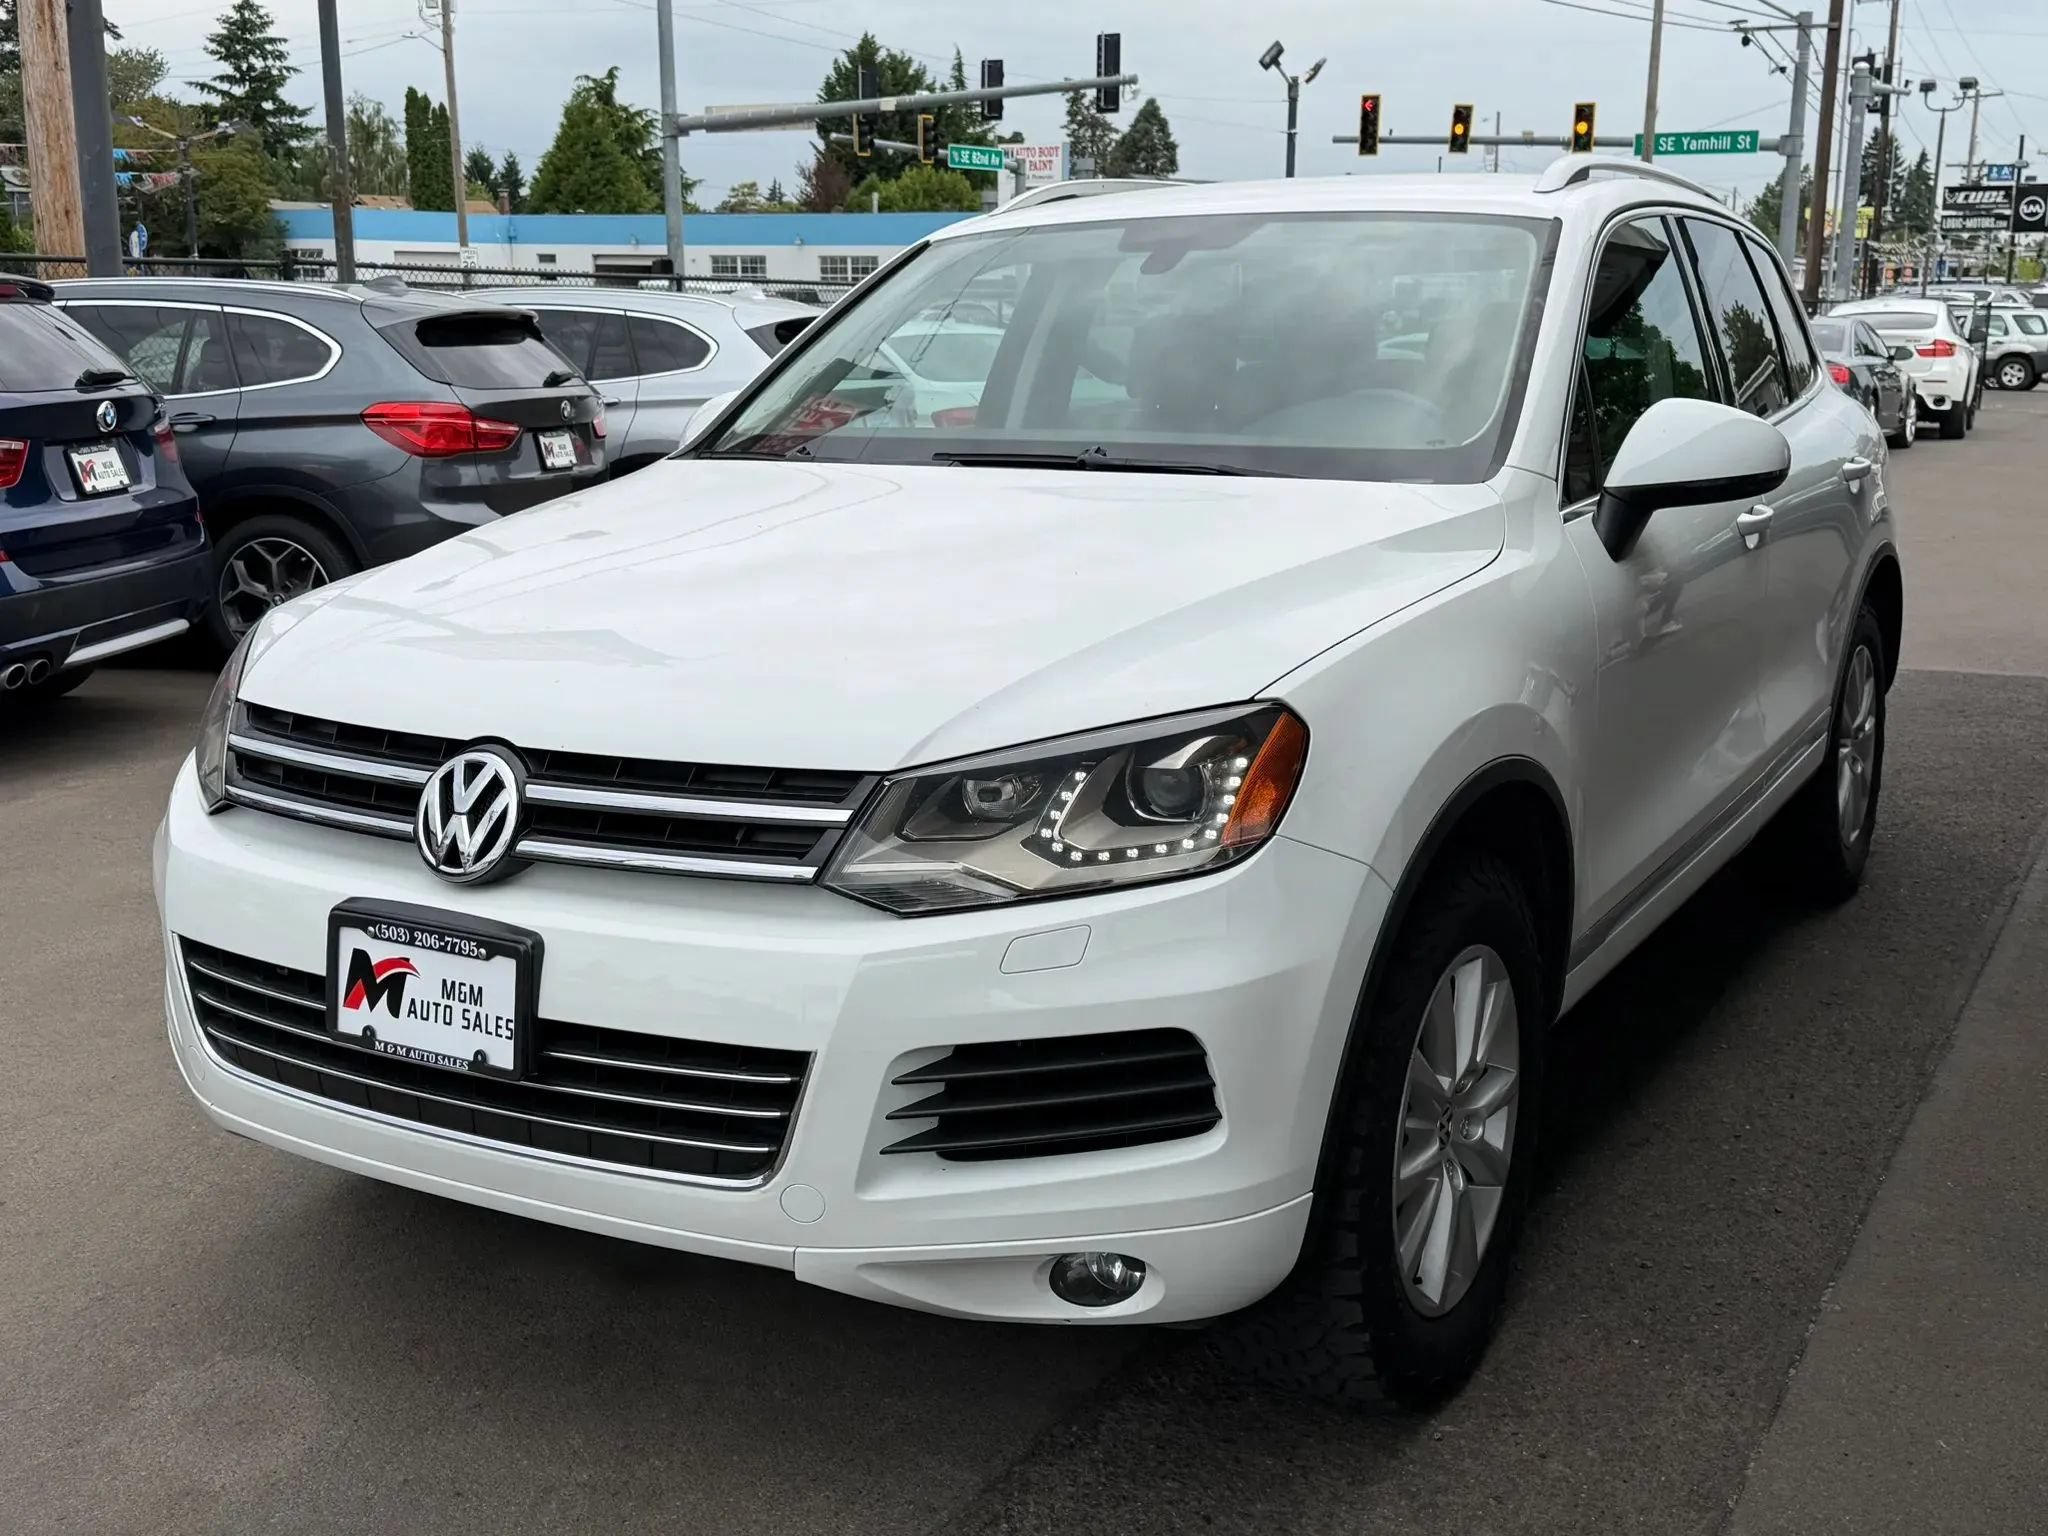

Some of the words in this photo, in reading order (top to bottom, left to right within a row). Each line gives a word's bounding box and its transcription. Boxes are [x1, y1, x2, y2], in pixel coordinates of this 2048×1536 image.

[1016, 146, 1037, 158] AUTO
[1038, 146, 1060, 157] BODY
[1658, 136, 1676, 151] SE
[1681, 135, 1731, 151] Yamhill
[1736, 134, 1751, 149] St
[960, 150, 970, 164] SE
[972, 151, 989, 165] 82nd
[1029, 160, 1053, 171] PAINT
[375, 923, 410, 943] (503)
[414, 931, 478, 957] 206-7795
[441, 978, 483, 1007] M&M
[407, 998, 453, 1026] AUTO
[461, 1009, 514, 1041] SALES
[374, 1041, 385, 1052] M
[387, 1043, 395, 1053] &
[396, 1045, 407, 1057] M
[408, 1049, 435, 1064] AUTO
[437, 1055, 469, 1071] SALES
